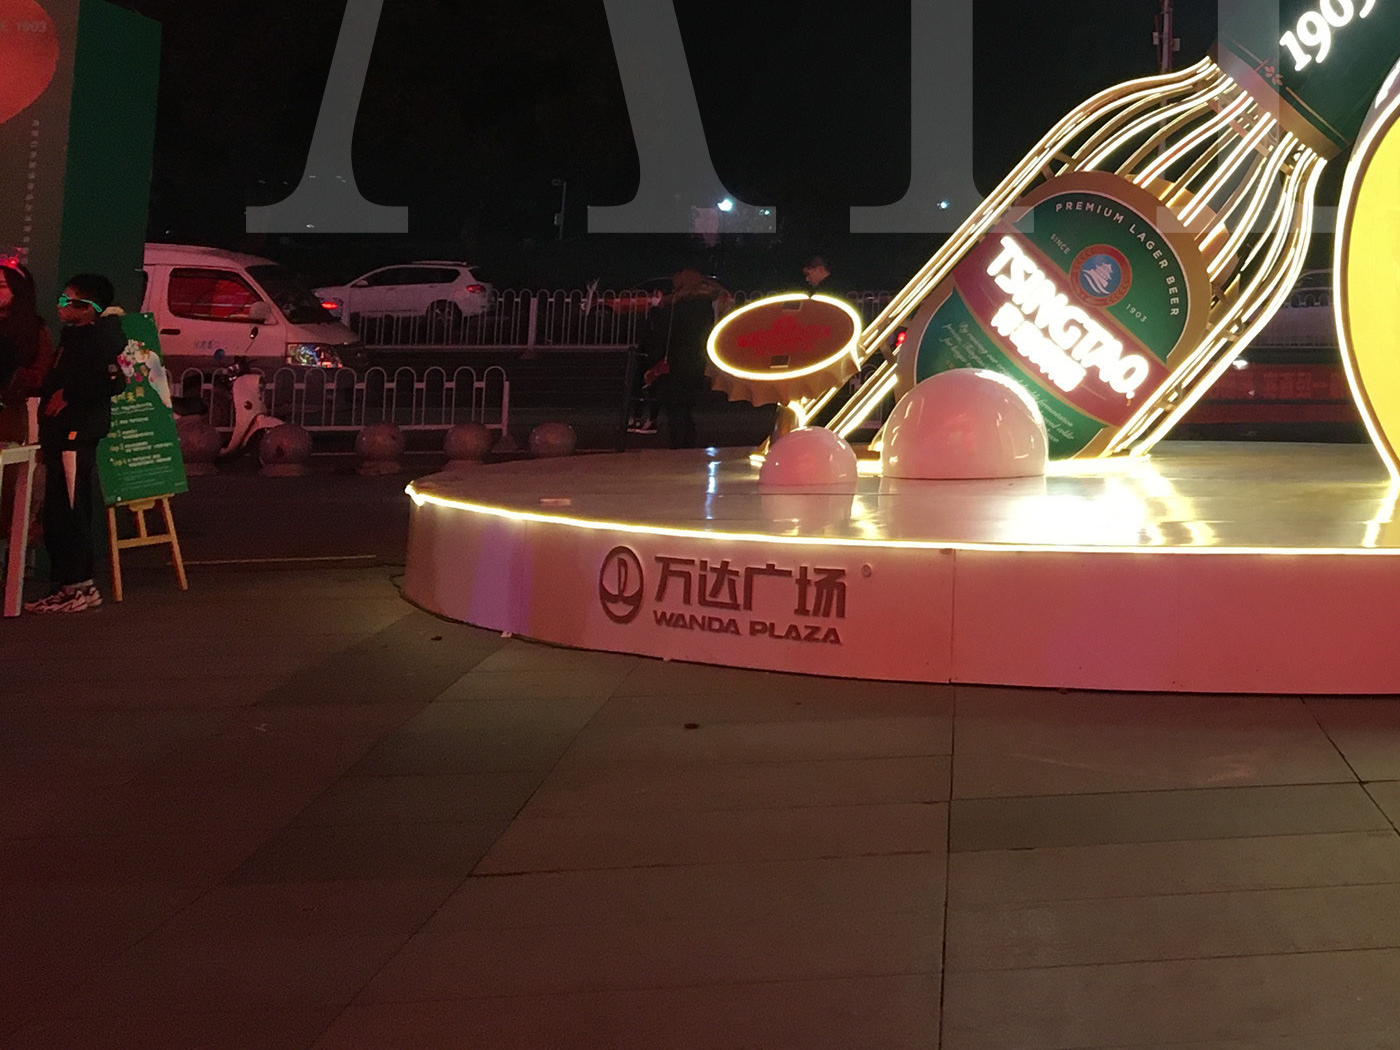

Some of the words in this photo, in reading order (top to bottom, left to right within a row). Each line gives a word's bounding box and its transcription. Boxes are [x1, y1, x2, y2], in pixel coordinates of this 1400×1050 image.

[1049, 233, 1071, 255] SINCE
[1125, 303, 1148, 323] 1903
[1055, 201, 1125, 224] PREMIUM
[1129, 224, 1169, 269] LAGER
[1165, 275, 1180, 316] BEER
[987, 236, 1149, 396] TSINGTAO
[653, 610, 743, 635] WANDA
[749, 621, 843, 645] PLAZA
[654, 556, 847, 618] 万达广场
